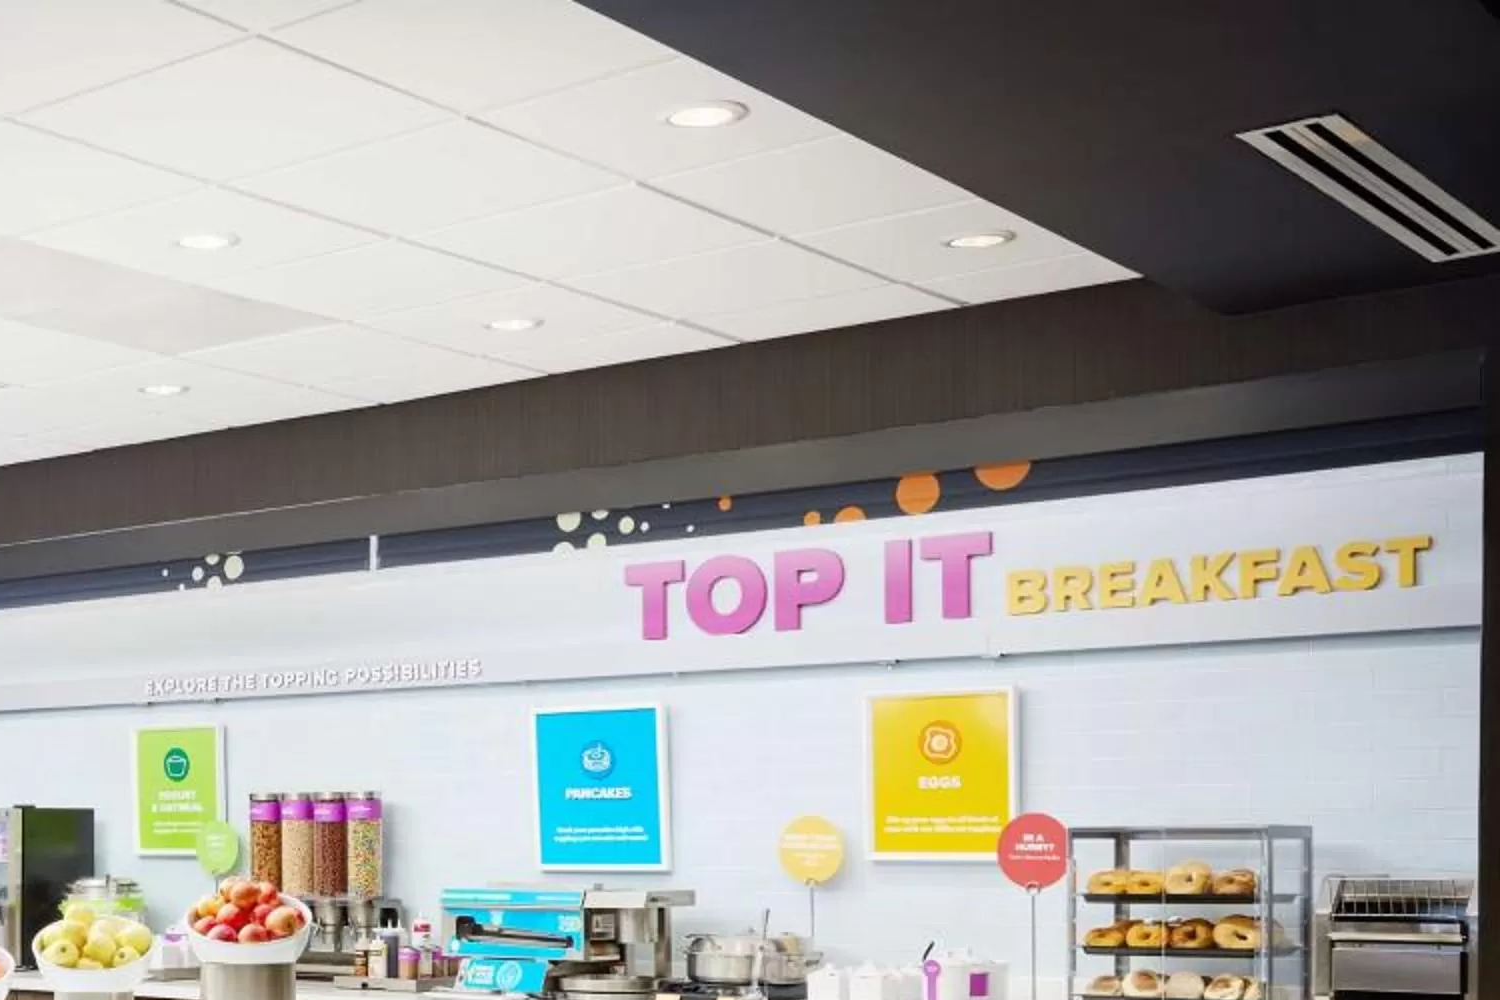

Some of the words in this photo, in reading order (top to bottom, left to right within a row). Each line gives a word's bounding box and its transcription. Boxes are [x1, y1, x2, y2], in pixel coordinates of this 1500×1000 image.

[625, 548, 846, 641] TOP
[883, 530, 994, 625] IT
[1008, 535, 1432, 615] BREAKFAST
[144, 676, 218, 697] EXPLORE
[222, 673, 258, 692] THE
[262, 667, 340, 689] TOPPING
[346, 657, 483, 685] POSSIBILITIES
[564, 786, 633, 800] PANCAKES
